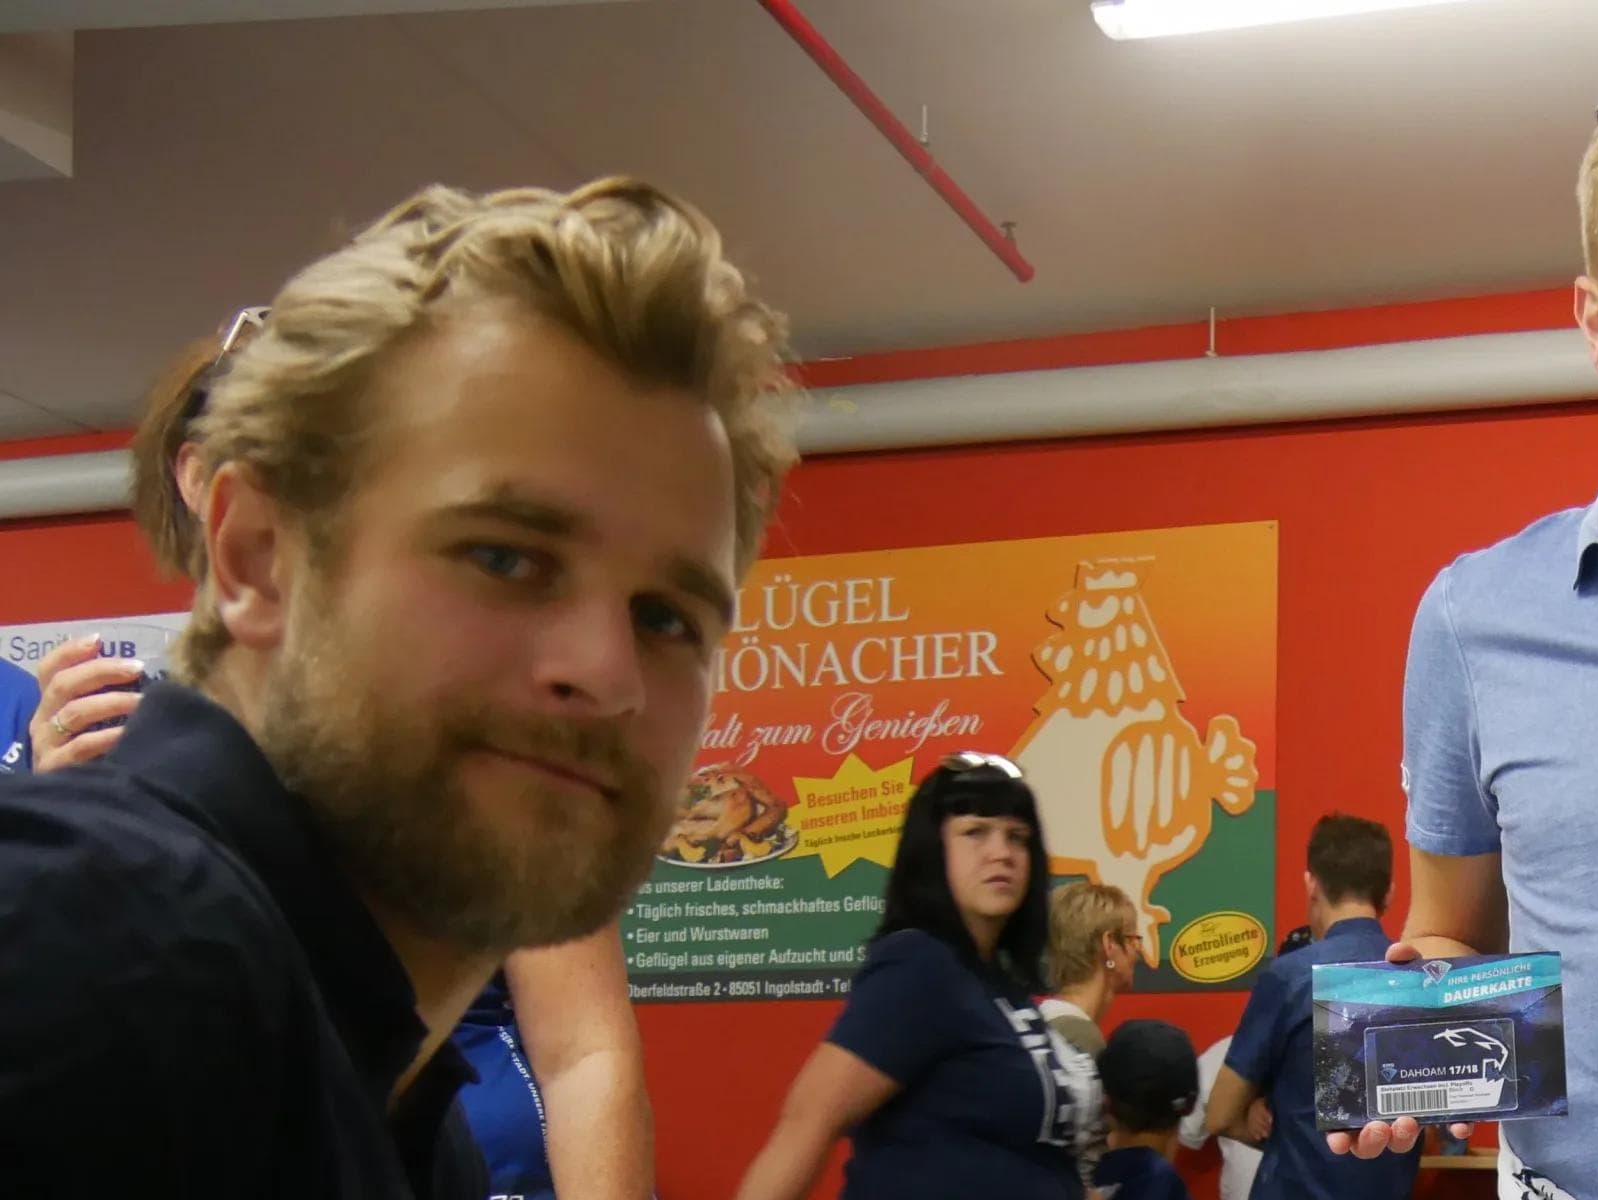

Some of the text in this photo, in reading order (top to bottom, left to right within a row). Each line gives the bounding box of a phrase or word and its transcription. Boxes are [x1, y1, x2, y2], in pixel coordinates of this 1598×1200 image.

[736, 720, 813, 766] zum
[822, 691, 984, 756] Genießen
[806, 780, 904, 809] Besuchen Sie
[800, 810, 858, 831] unseren
[655, 879, 704, 894] unserer
[706, 875, 785, 893] Ladentheke:
[635, 903, 682, 922] Täglich
[684, 901, 740, 918] frisches,
[742, 897, 841, 916] schmackhaftes
[635, 926, 770, 944] Eier und Wurstwaren
[1178, 929, 1259, 958] Kontrollierte
[635, 952, 689, 970] Geflügel
[690, 953, 714, 966] aus
[716, 953, 765, 969] eigener
[768, 947, 827, 965] Aufzucht
[829, 946, 854, 963] und
[1193, 947, 1249, 968] Erzeugung
[1471, 962, 1532, 982] PERSÖNLICHE
[713, 982, 721, 996] 2
[728, 981, 761, 996] 85051
[764, 979, 825, 998] Ingolstadt
[1443, 975, 1533, 1004] DAUERKARTE
[1400, 1064, 1478, 1079] DAHOAM 17/18
